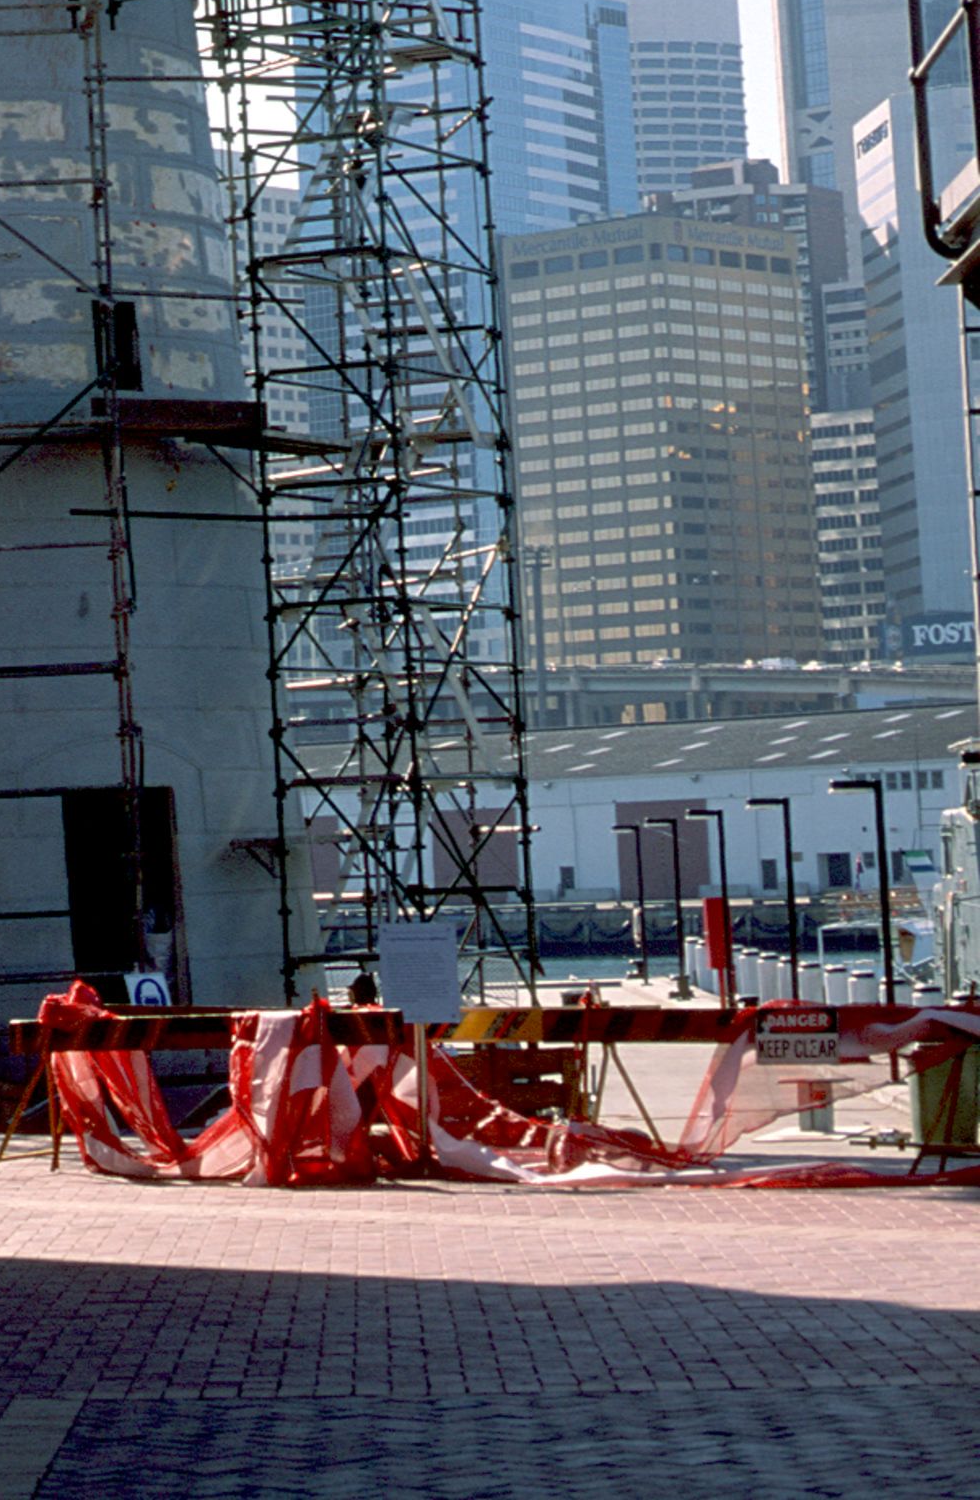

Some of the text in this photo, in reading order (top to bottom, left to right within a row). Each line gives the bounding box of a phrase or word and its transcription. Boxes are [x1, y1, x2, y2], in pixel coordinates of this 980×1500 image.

[513, 226, 644, 258] Mercantile Mutual
[687, 227, 785, 252] Mercantile Mutual
[766, 1013, 829, 1028] DANGER
[758, 1038, 837, 1058] KEEP CLEAR
